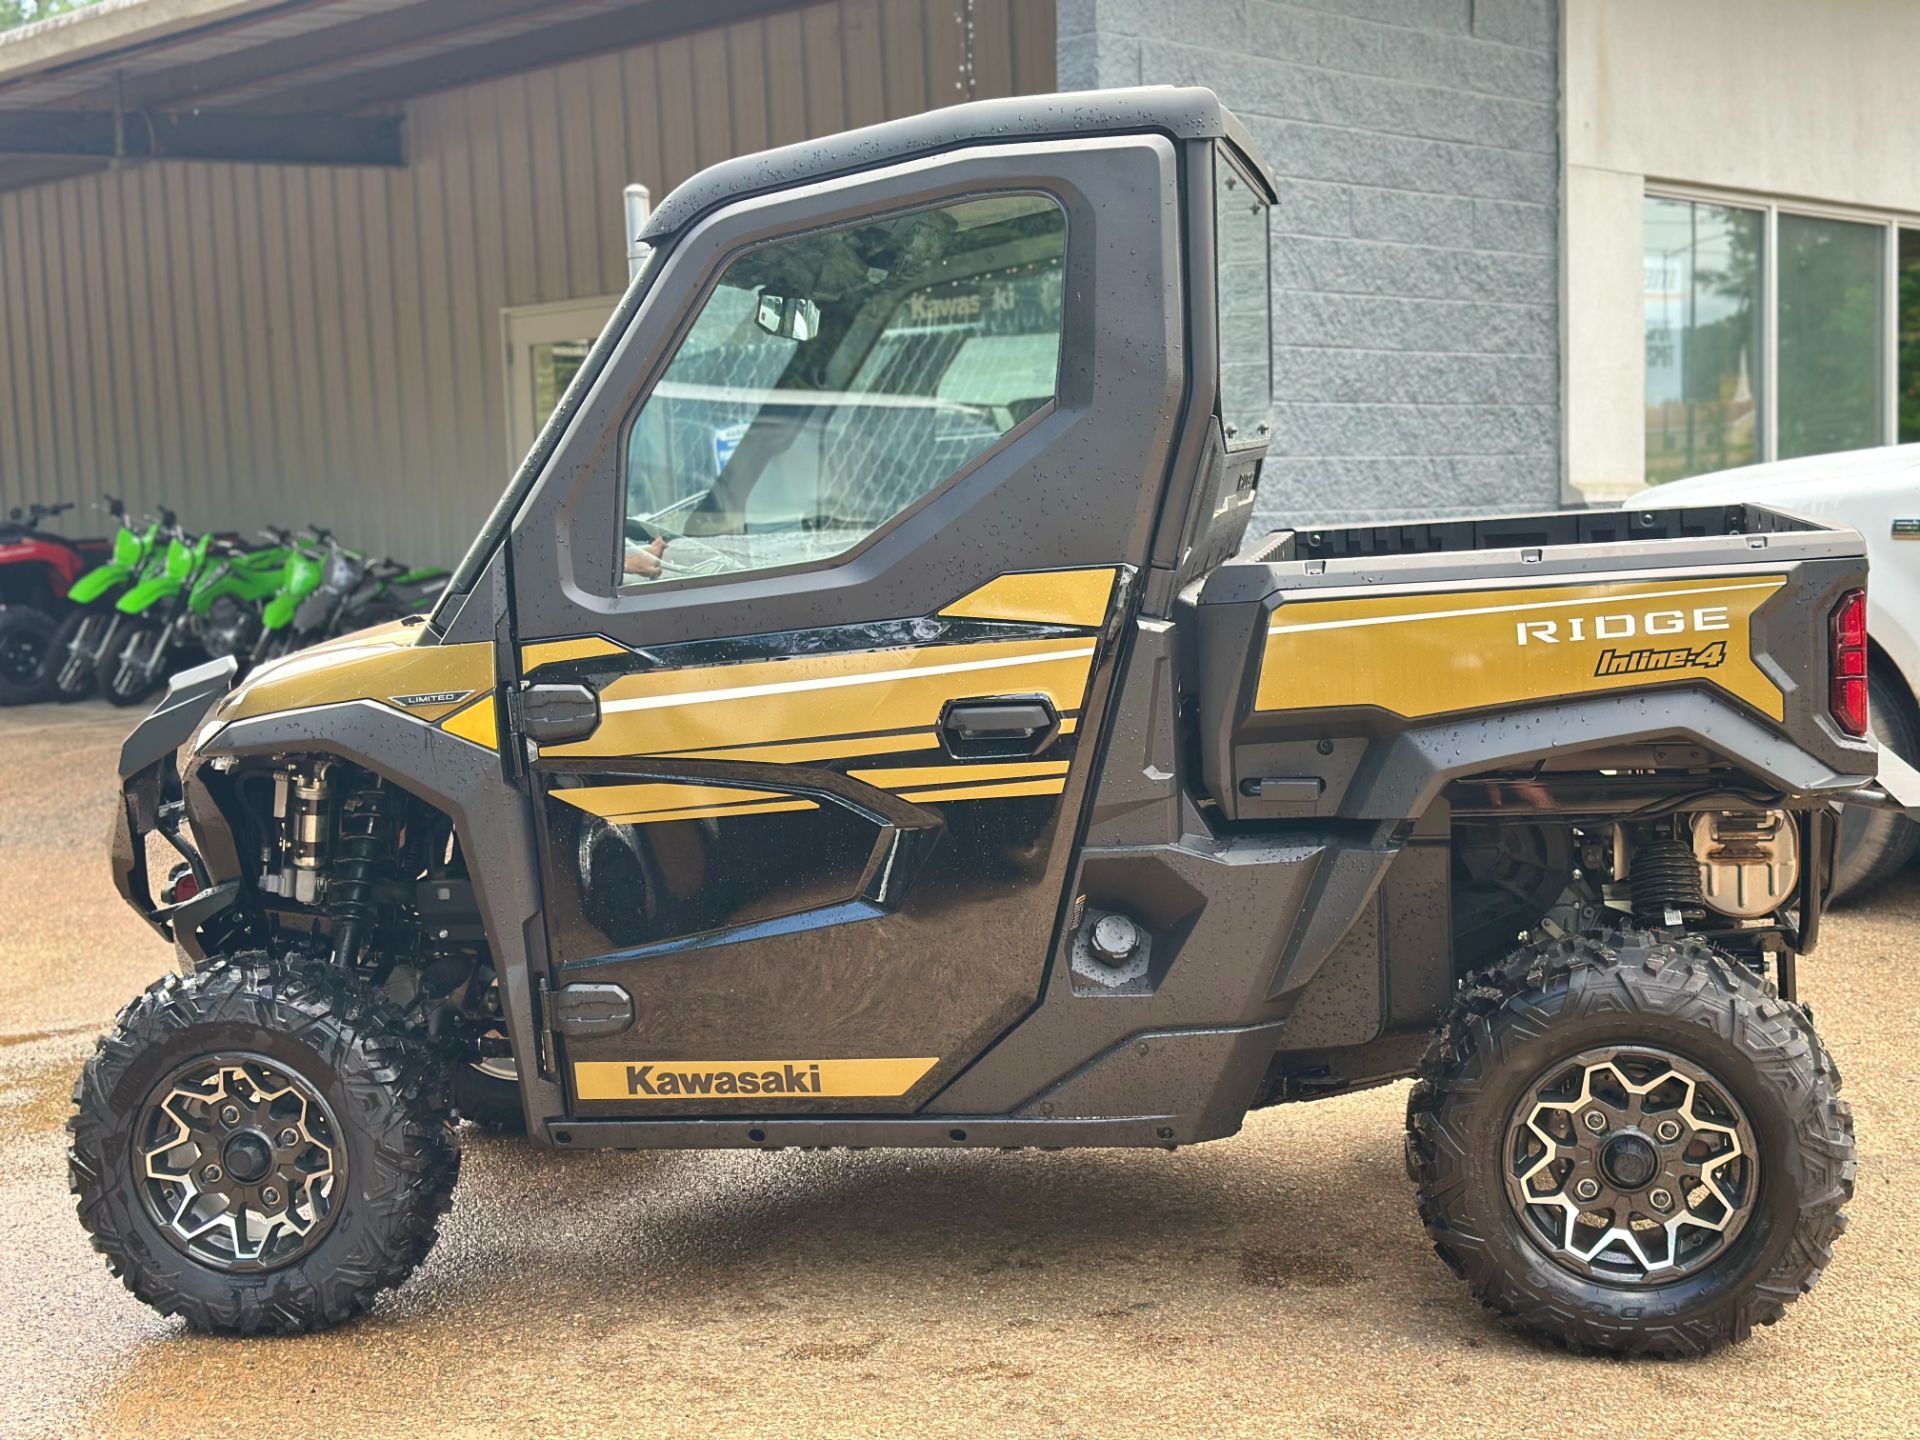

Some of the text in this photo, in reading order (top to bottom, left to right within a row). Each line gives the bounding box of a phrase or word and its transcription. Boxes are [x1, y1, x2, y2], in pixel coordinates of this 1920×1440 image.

[1516, 606, 1729, 646] RIDGE
[1594, 641, 1727, 676] Inline-4
[408, 693, 454, 703] LIMITED
[626, 1064, 822, 1095] Kawasaki
